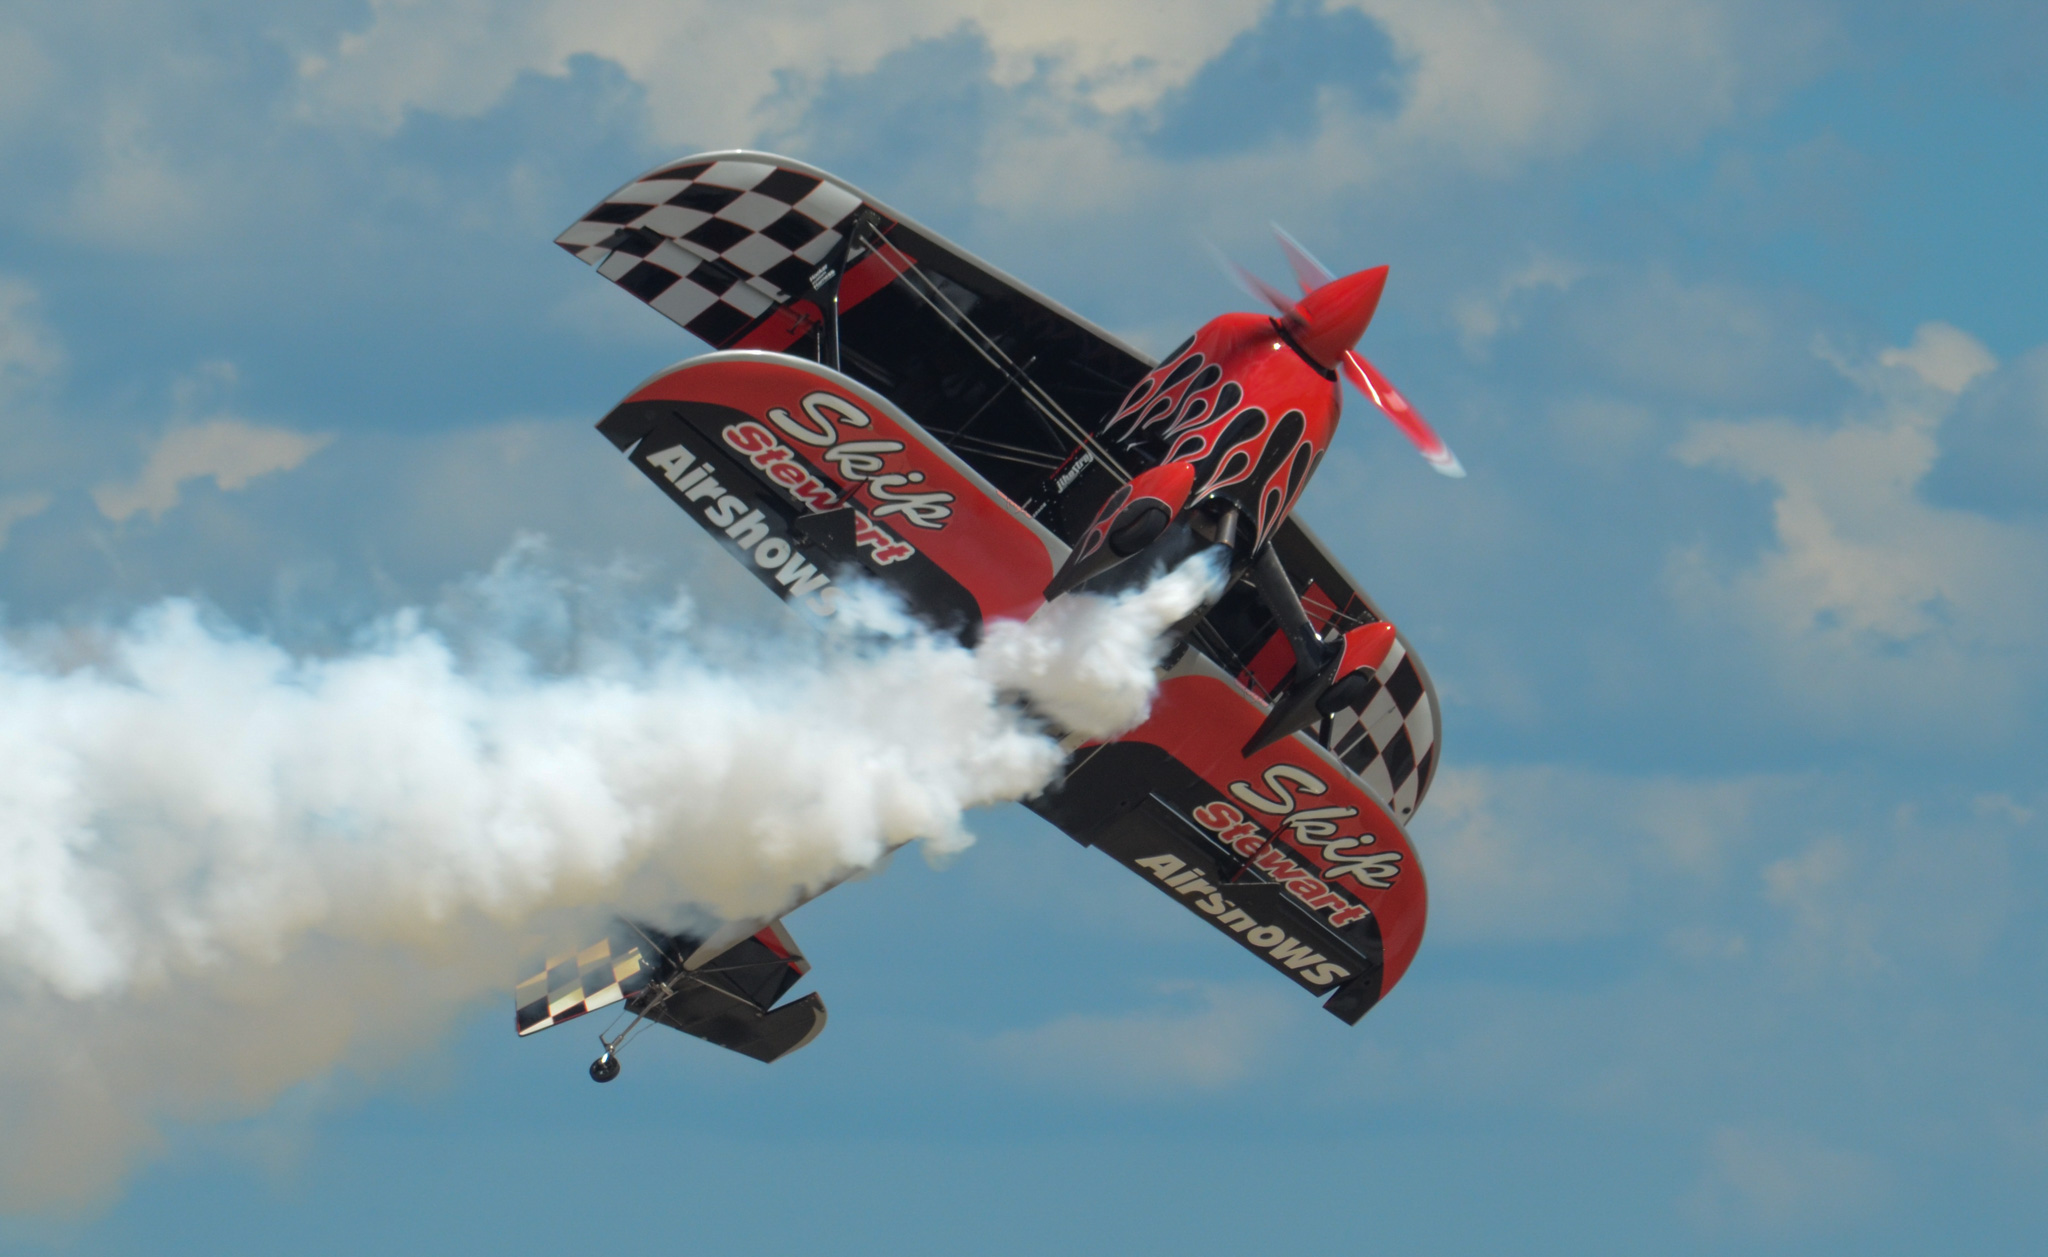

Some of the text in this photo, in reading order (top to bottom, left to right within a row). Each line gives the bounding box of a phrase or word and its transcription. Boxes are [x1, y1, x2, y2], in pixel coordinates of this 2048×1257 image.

[767, 391, 956, 530] Skip
[646, 445, 847, 617] Airshows
[1193, 801, 1370, 928] Stewart
[1229, 764, 1403, 890] Skip
